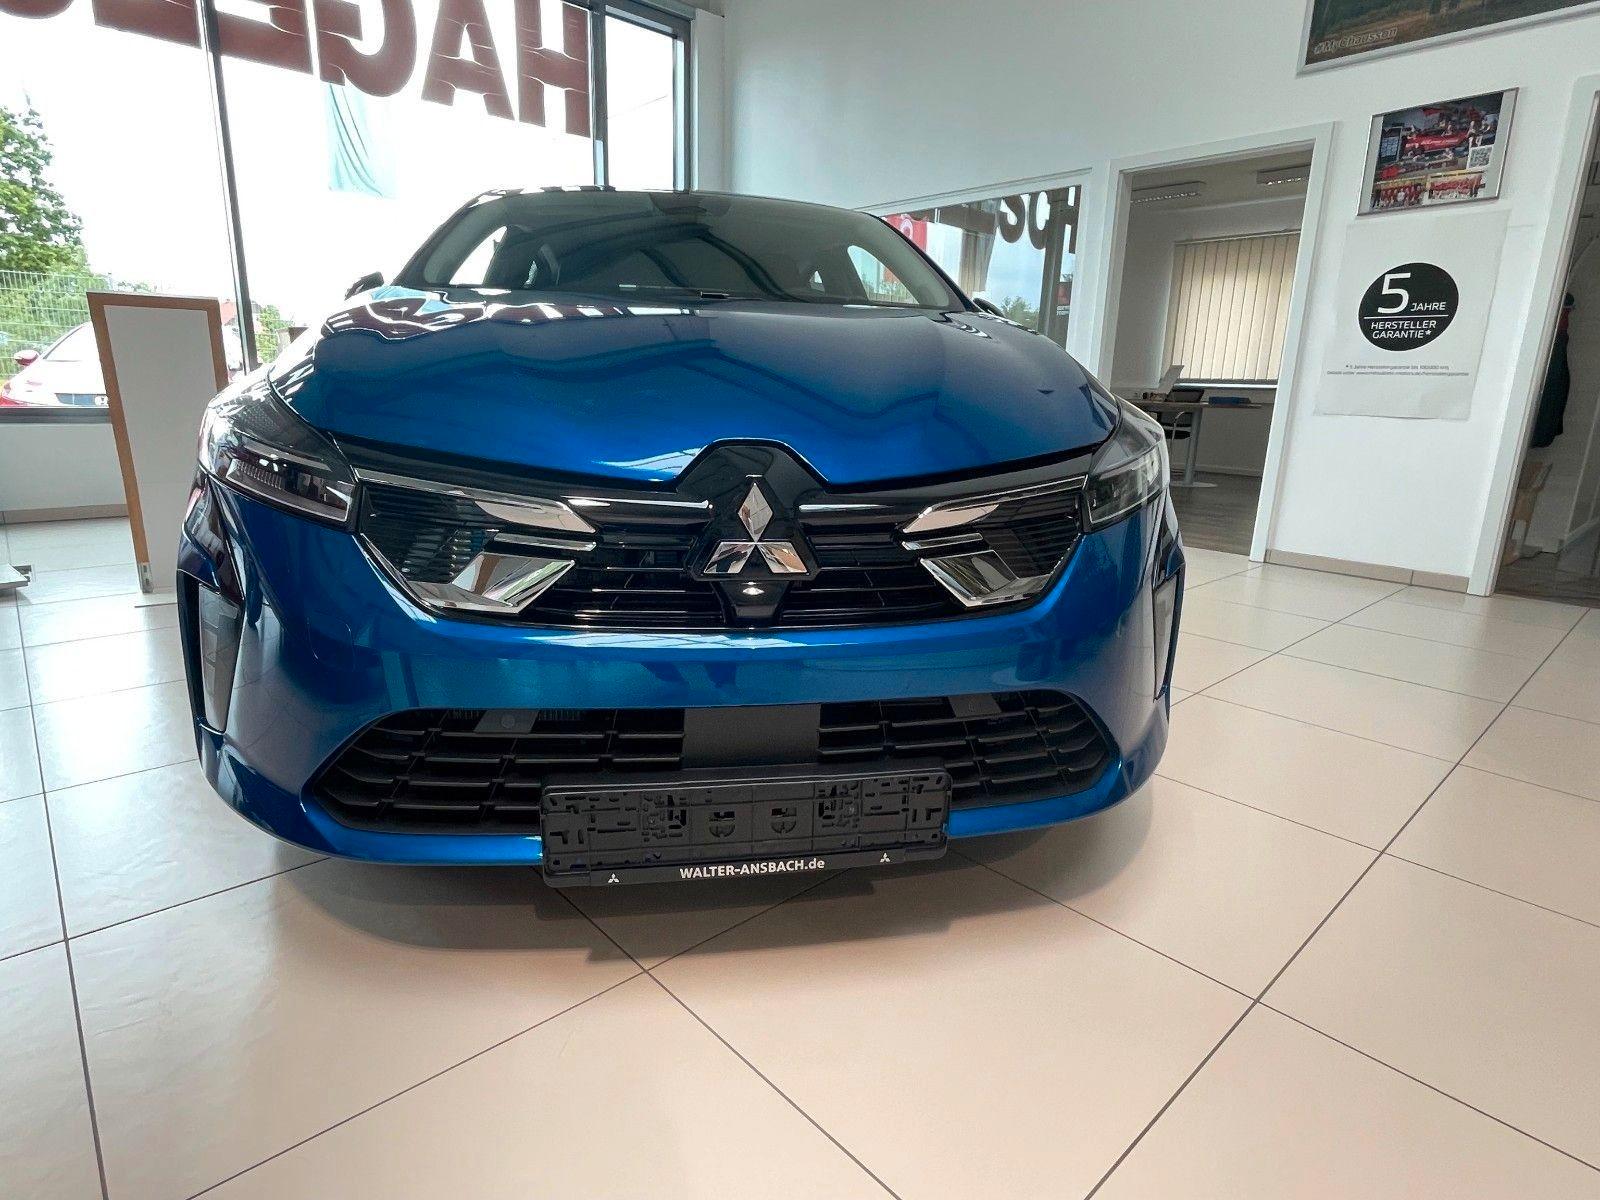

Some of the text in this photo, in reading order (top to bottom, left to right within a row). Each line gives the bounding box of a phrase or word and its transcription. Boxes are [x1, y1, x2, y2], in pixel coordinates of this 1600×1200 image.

[1377, 272, 1447, 314] 5 JAHRE
[1370, 320, 1437, 330] HERSTELLER
[679, 858, 826, 880] WALTER-ANSBACH.de
